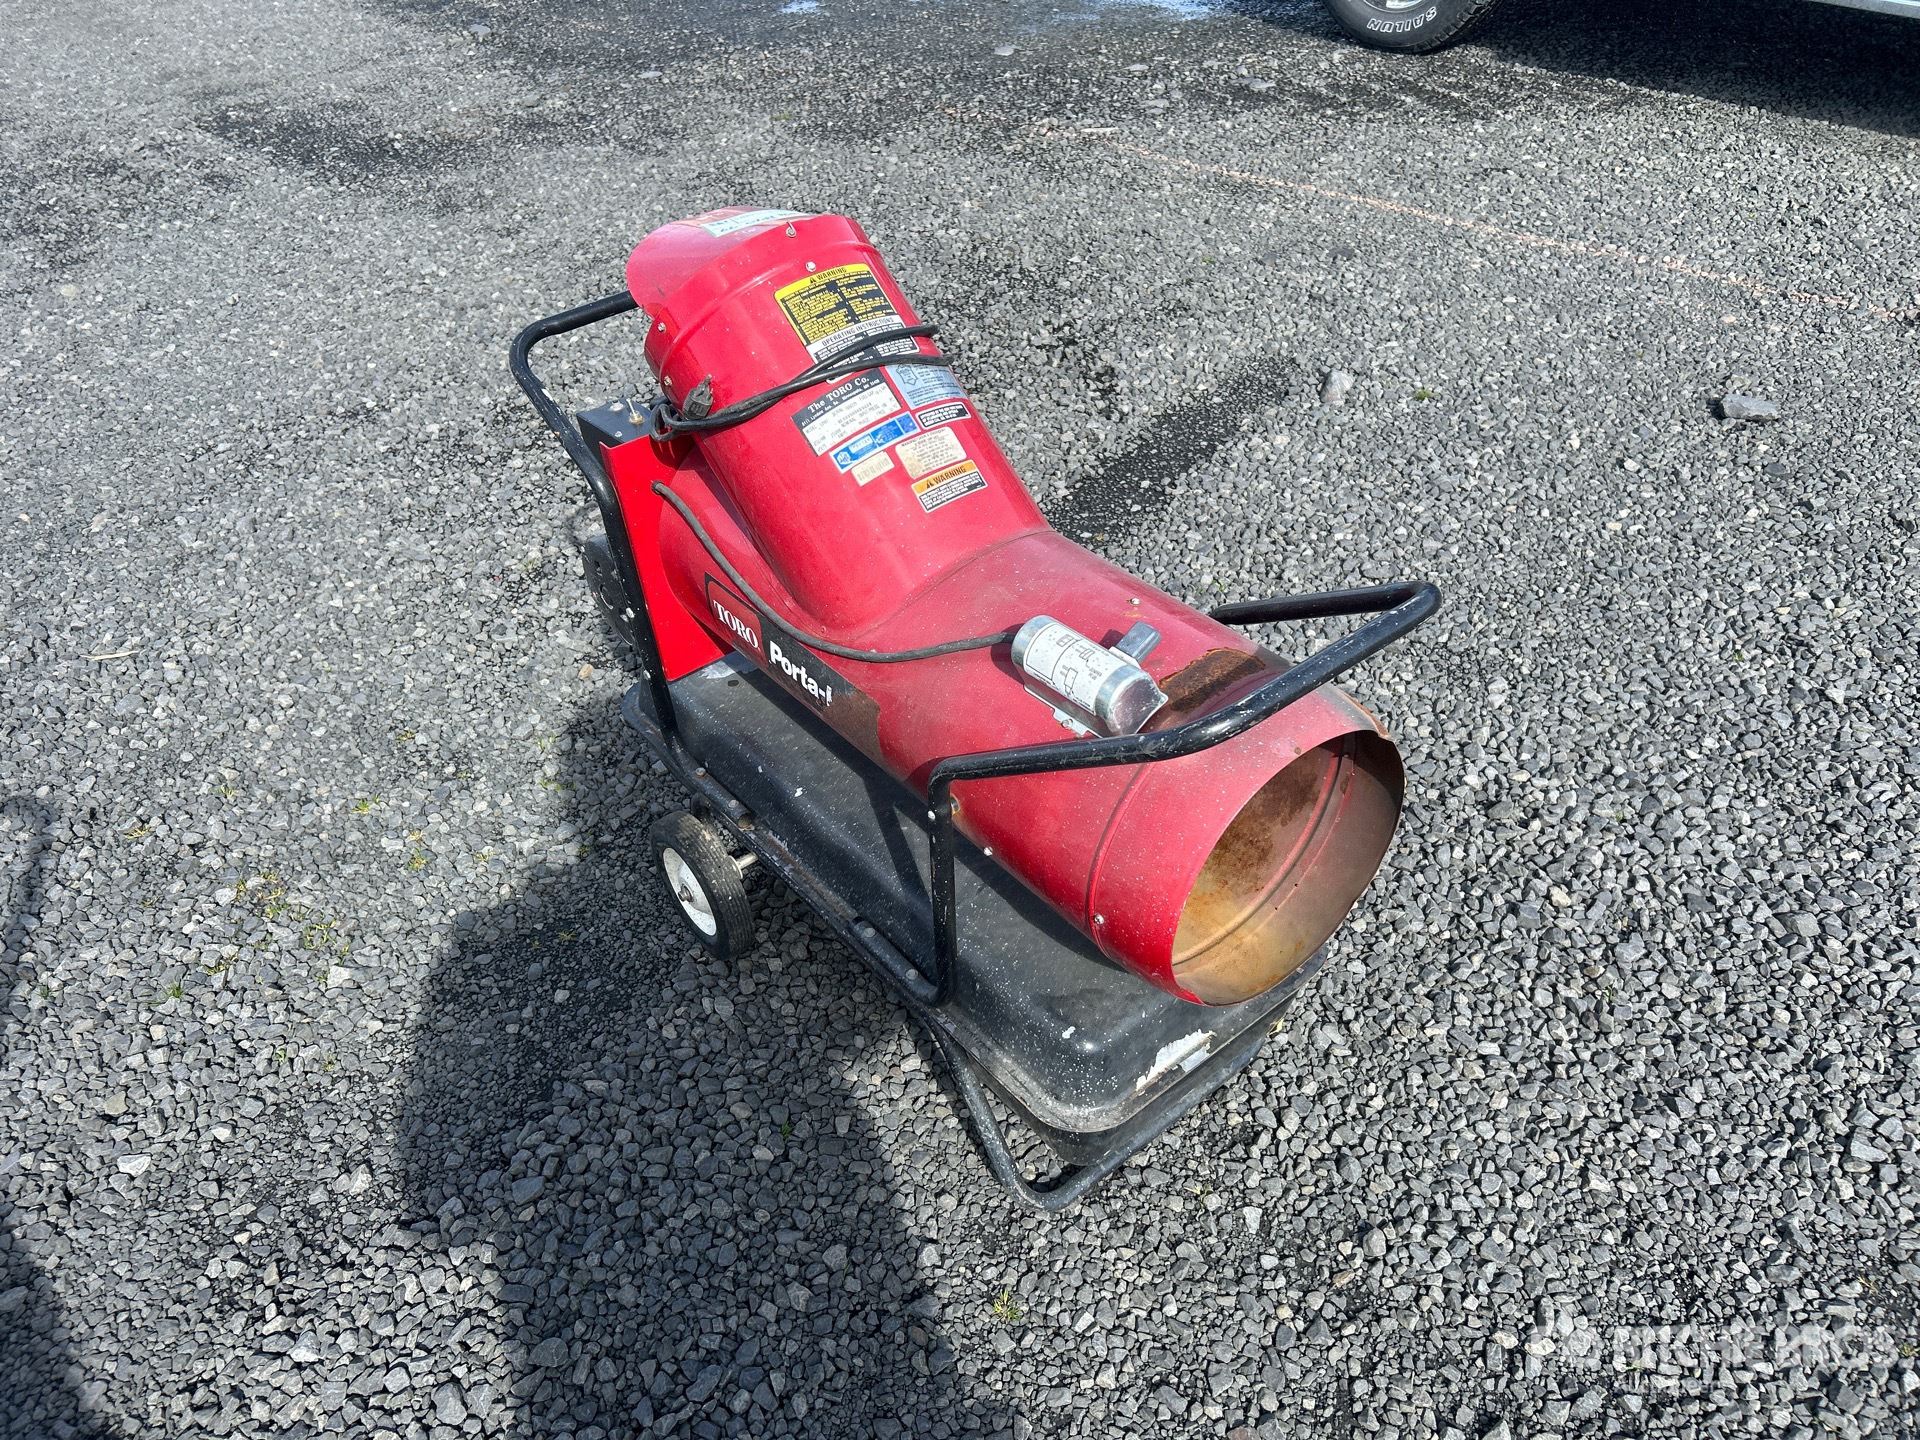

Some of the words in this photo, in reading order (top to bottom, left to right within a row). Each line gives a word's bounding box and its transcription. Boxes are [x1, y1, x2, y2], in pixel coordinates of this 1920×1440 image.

[1366, 6, 1437, 33] SAILUN
[817, 267, 847, 281] WARNING
[821, 327, 857, 347] OPERATING
[856, 316, 895, 332] INSTRUCTIONS
[807, 400, 826, 414] The
[826, 382, 853, 401] TORO
[854, 377, 870, 386] Co.
[933, 465, 967, 485] WARNING
[713, 599, 759, 649] TORO
